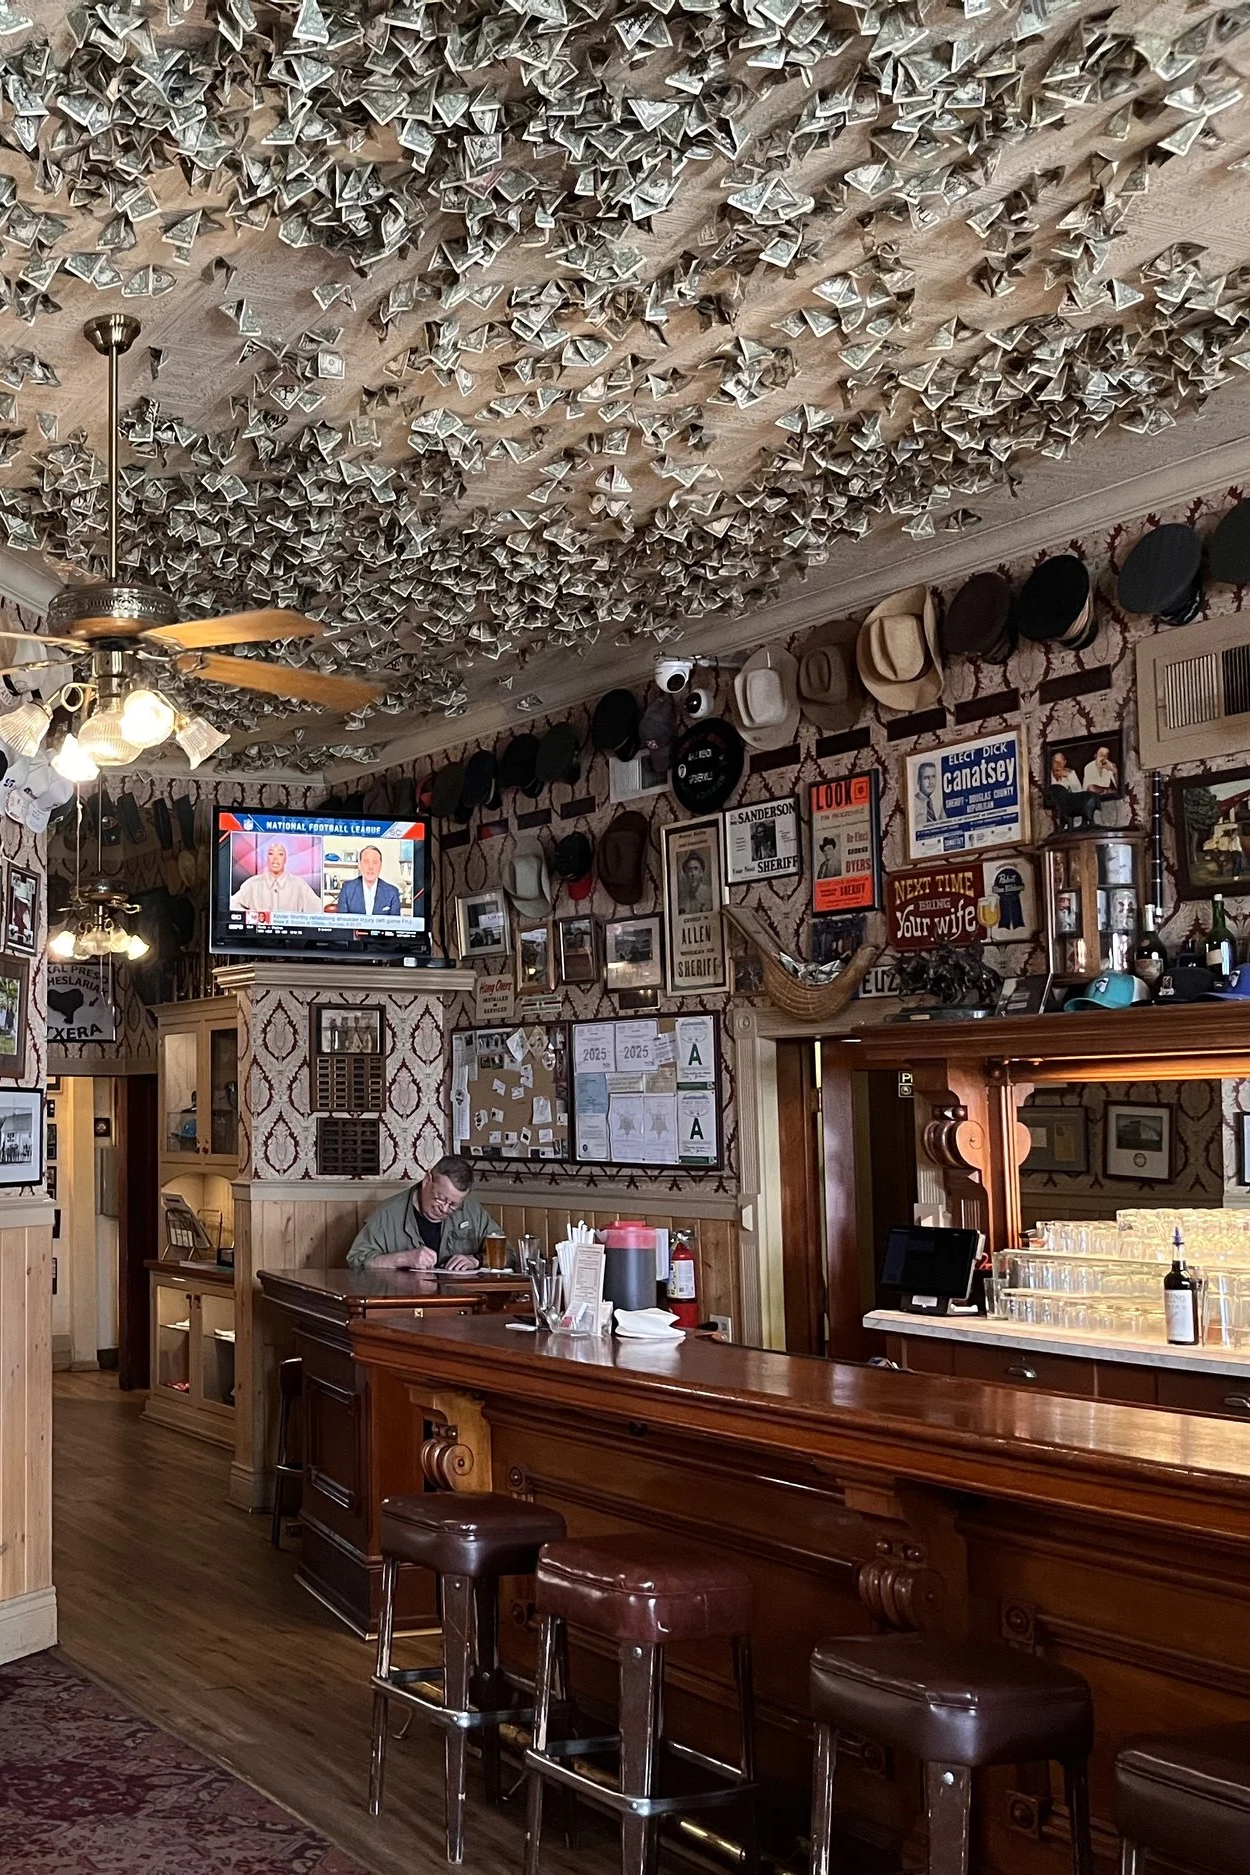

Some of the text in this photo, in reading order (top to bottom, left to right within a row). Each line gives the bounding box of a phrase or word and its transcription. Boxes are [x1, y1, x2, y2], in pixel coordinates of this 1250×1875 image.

[948, 742, 1008, 766] ELECT DICK
[816, 779, 852, 810] LOOK
[993, 786, 1014, 799] COUNTY
[738, 801, 796, 824] SANDERSON
[266, 821, 381, 834] NATIONAL FOOTBALL LEAGUE
[757, 855, 798, 873] SHERIFF
[894, 877, 932, 906] NEXT
[936, 872, 975, 898] TIME
[919, 898, 951, 911] BRING
[896, 899, 976, 940] Your wife
[682, 925, 711, 944] ALLEN
[678, 957, 718, 977] SHERIFF
[583, 1047, 607, 1061] 2025
[624, 1045, 649, 1059] 2025
[688, 1043, 703, 1066] A
[689, 1117, 704, 1140] A
